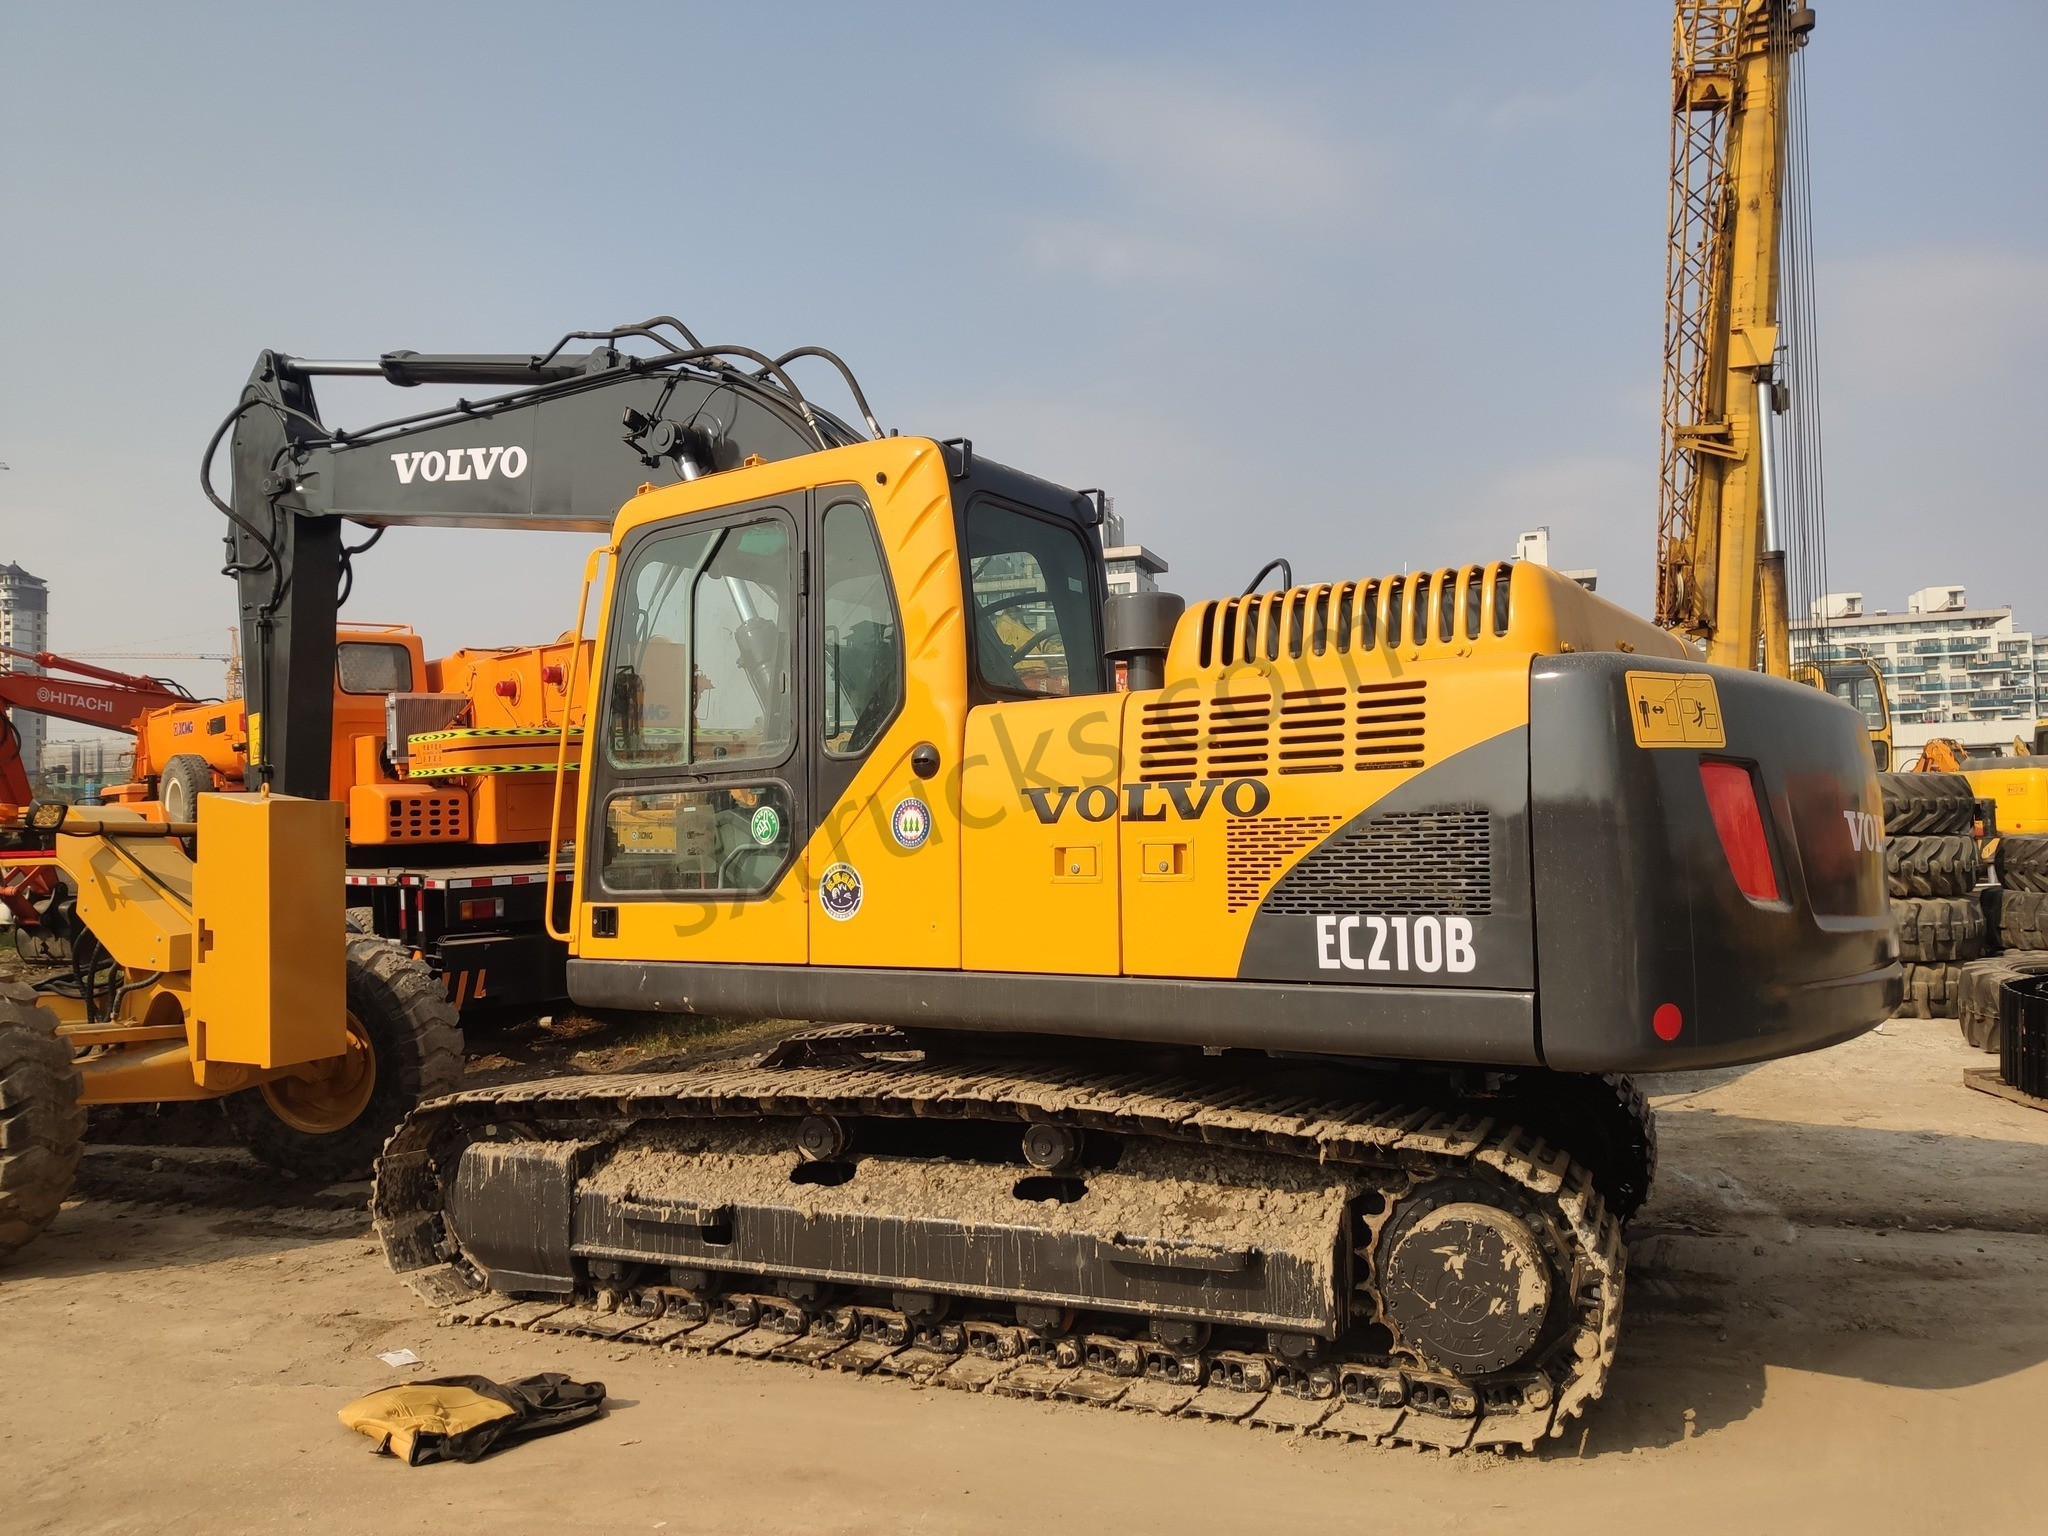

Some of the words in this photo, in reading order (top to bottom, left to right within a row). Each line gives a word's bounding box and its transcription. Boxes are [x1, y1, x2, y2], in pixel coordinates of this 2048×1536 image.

[391, 445, 528, 484] VOLVO
[50, 692, 113, 713] HITACHI
[1021, 778, 1271, 824] VOLVO
[1316, 915, 1477, 973] EC210B
